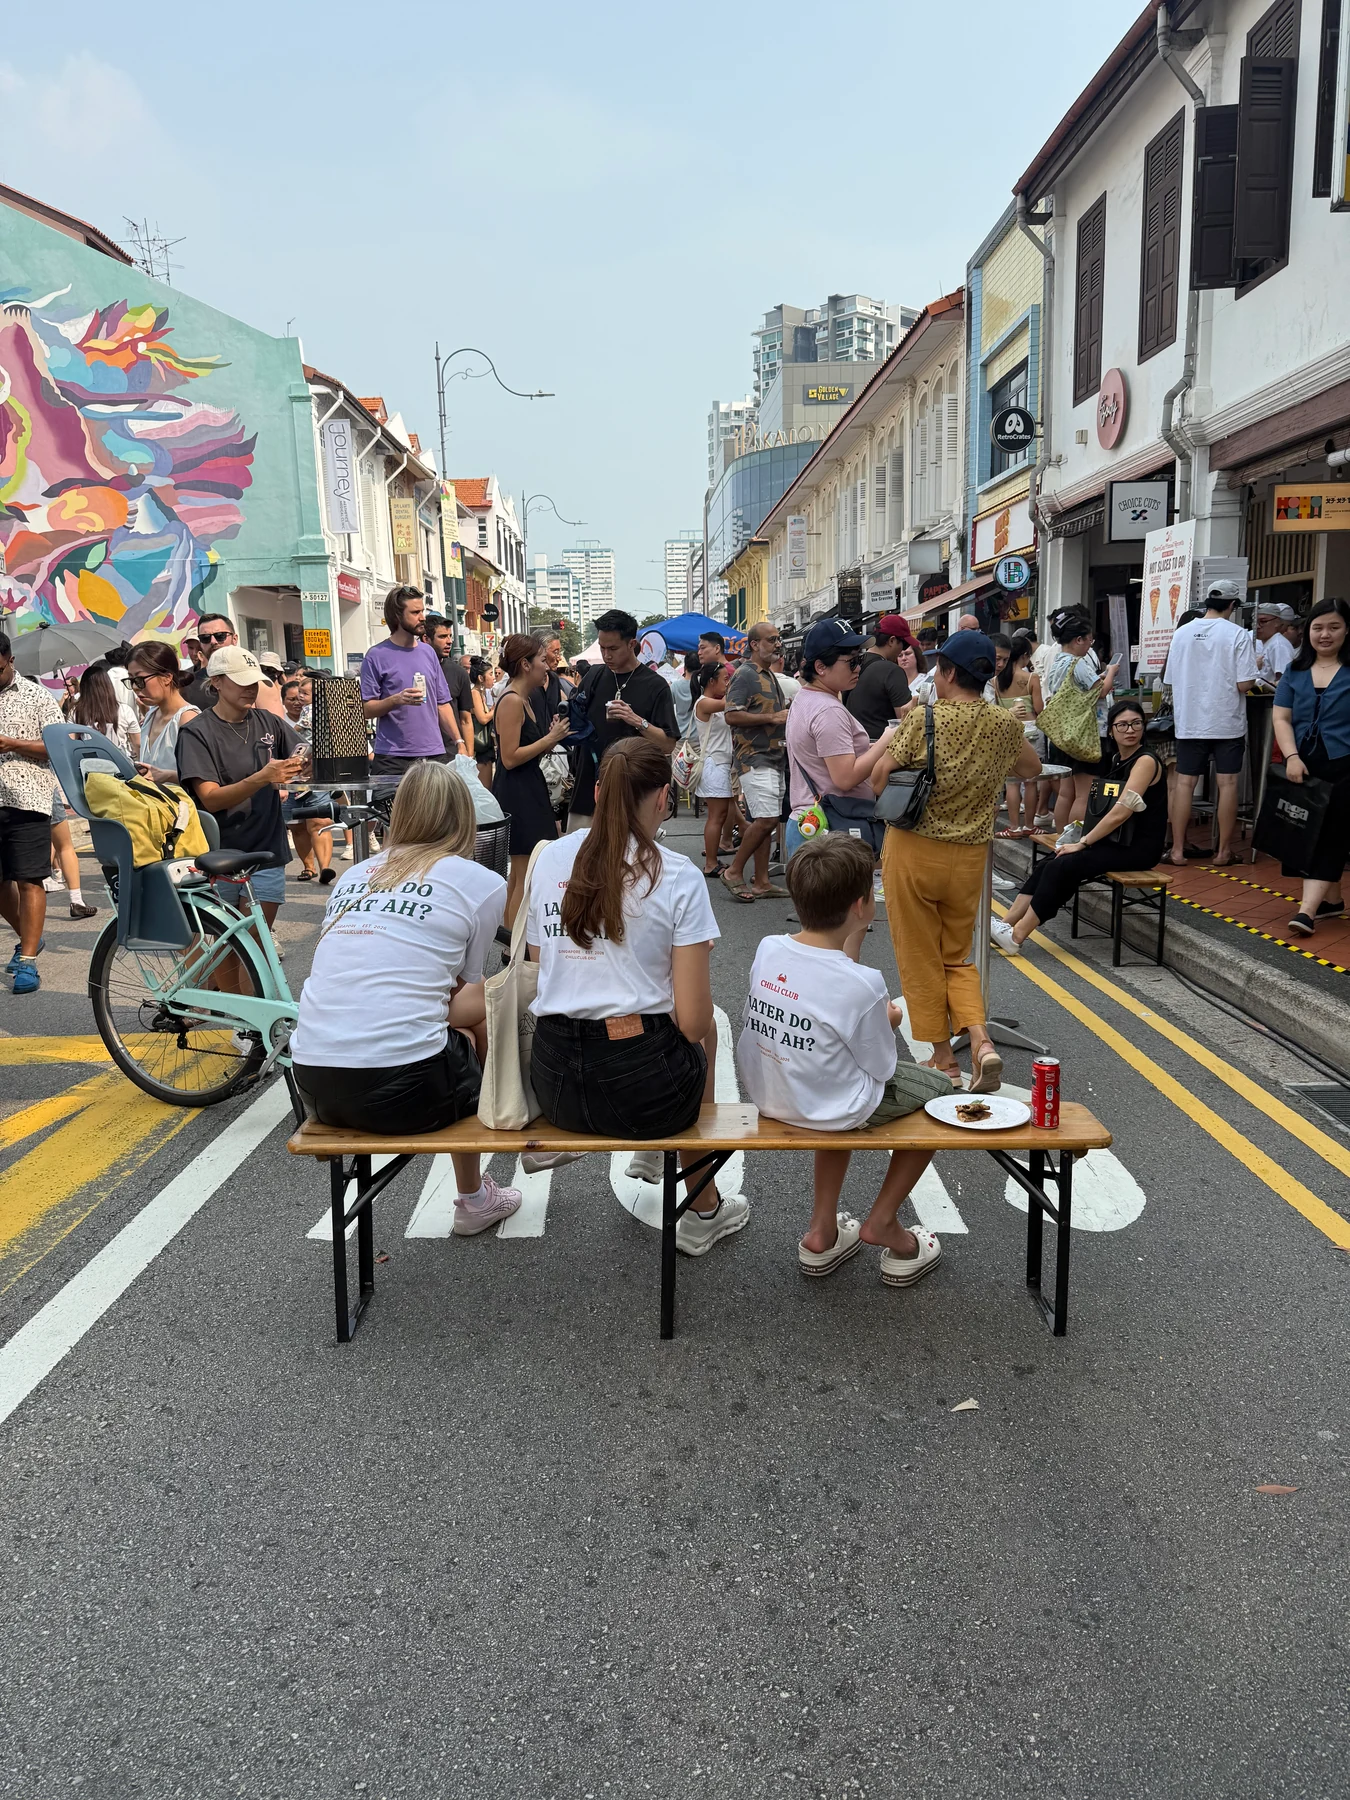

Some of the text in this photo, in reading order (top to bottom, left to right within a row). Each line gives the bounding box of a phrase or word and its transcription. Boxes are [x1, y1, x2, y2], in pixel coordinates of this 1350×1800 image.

[818, 385, 838, 393] GOLDEN
[763, 421, 836, 449] KATON
[328, 423, 351, 501] Journey
[1118, 497, 1161, 511] CHOICE CUTS
[1149, 561, 1157, 574] HOT
[1158, 558, 1171, 572] SLICES
[1172, 557, 1178, 569] TO
[1178, 555, 1186, 568] GO!
[1277, 798, 1309, 821] rega
[400, 882, 433, 897] DO
[380, 899, 433, 920] AH?
[760, 979, 799, 1000] CHILLI CLUB
[789, 1013, 812, 1031] DO
[780, 1031, 815, 1051] AH?
